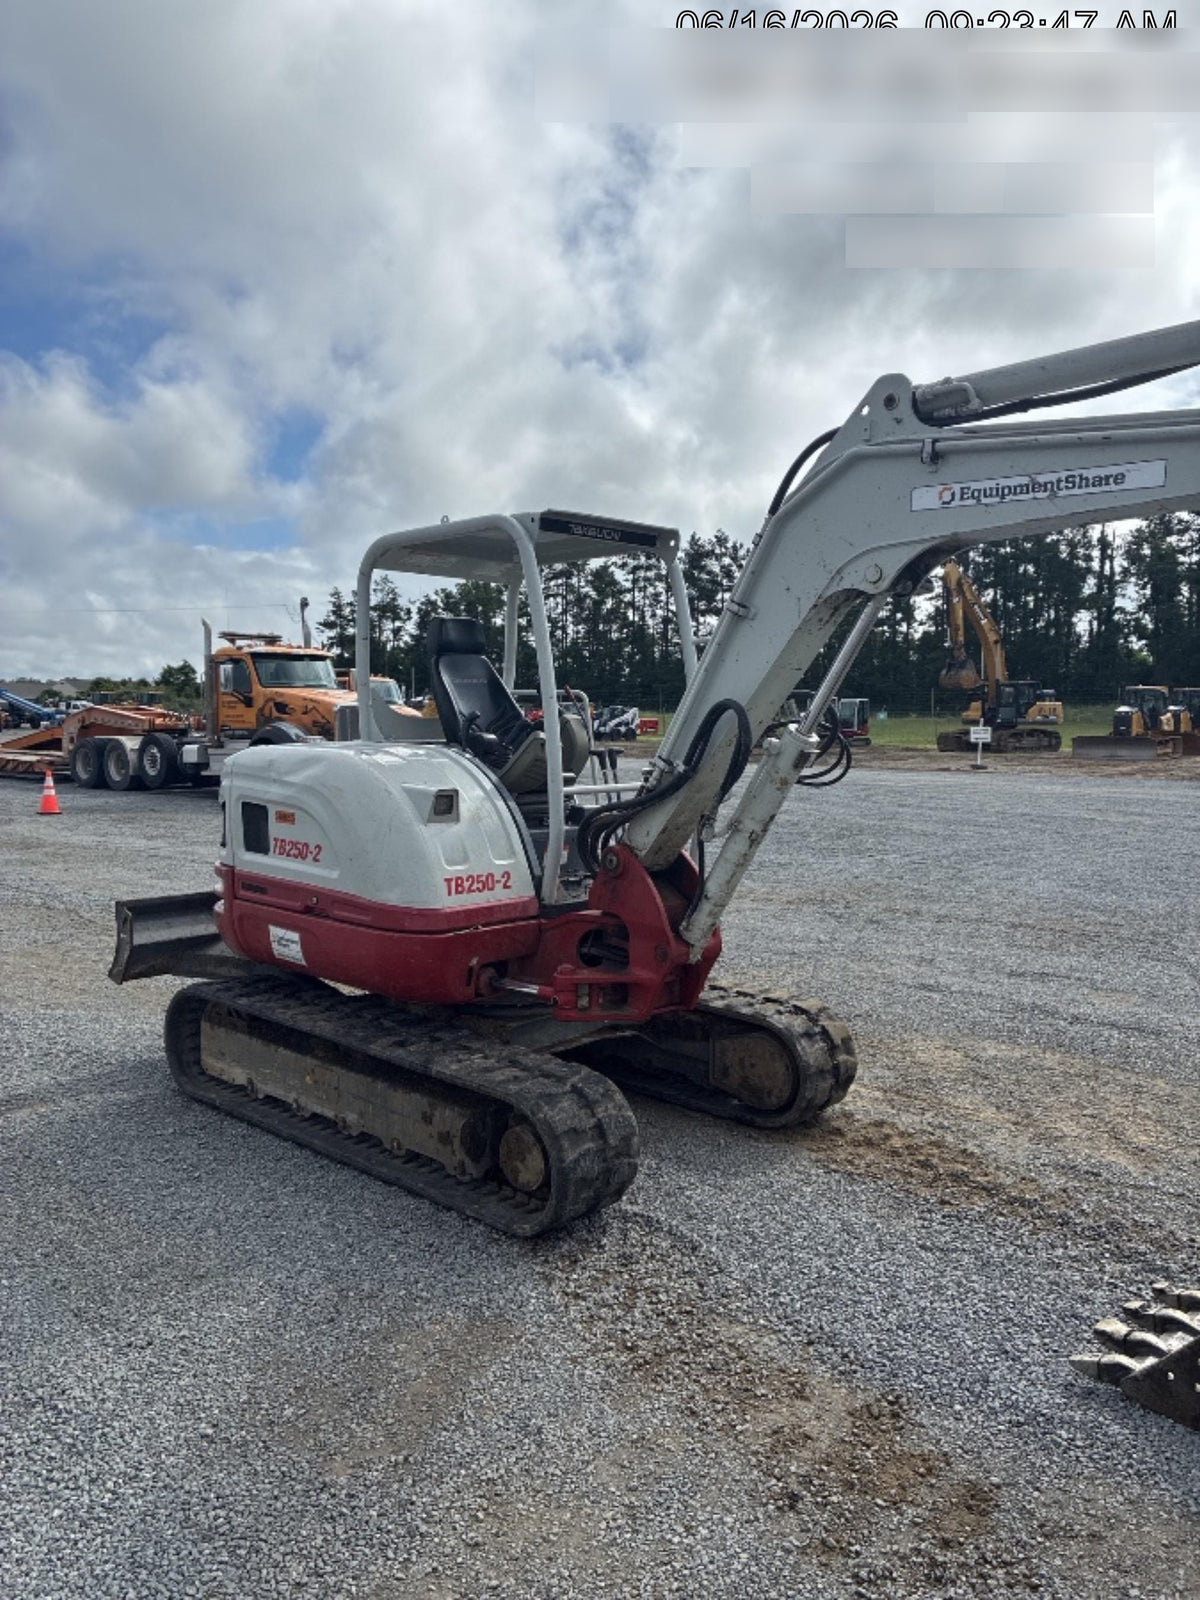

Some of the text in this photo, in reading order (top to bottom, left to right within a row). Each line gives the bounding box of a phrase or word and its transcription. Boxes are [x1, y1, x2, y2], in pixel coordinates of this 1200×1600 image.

[959, 470, 1126, 503] EquipmentShare
[273, 837, 322, 863] TB250-2
[443, 870, 512, 897] TB250-2
